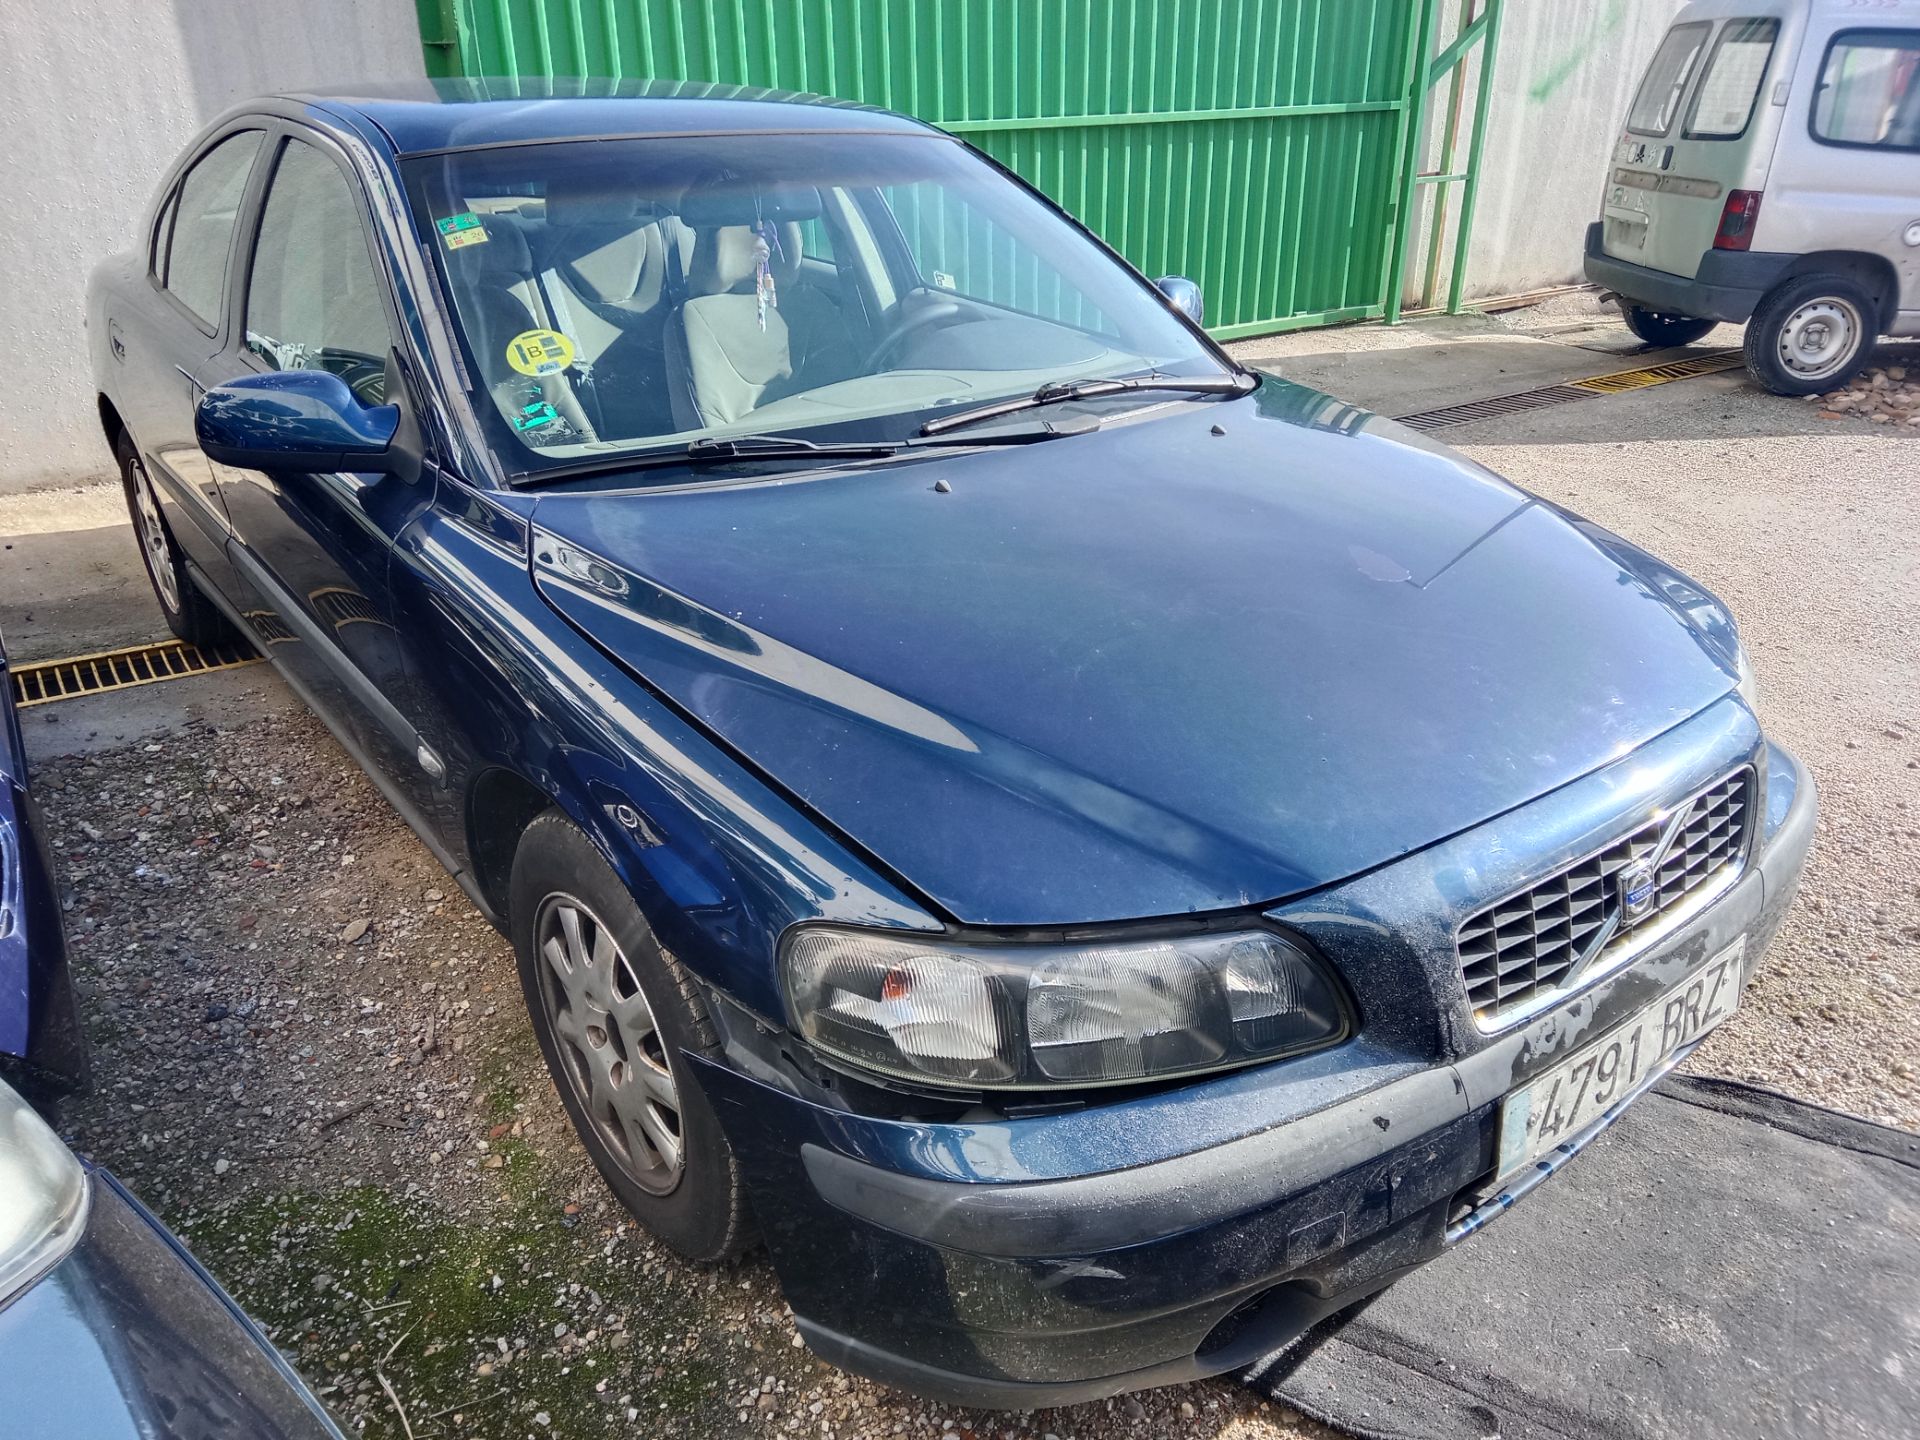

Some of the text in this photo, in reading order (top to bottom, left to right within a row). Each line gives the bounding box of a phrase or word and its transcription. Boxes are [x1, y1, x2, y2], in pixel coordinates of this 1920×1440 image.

[526, 345, 542, 359] B
[1537, 959, 1729, 1139] 4791 BRZ
